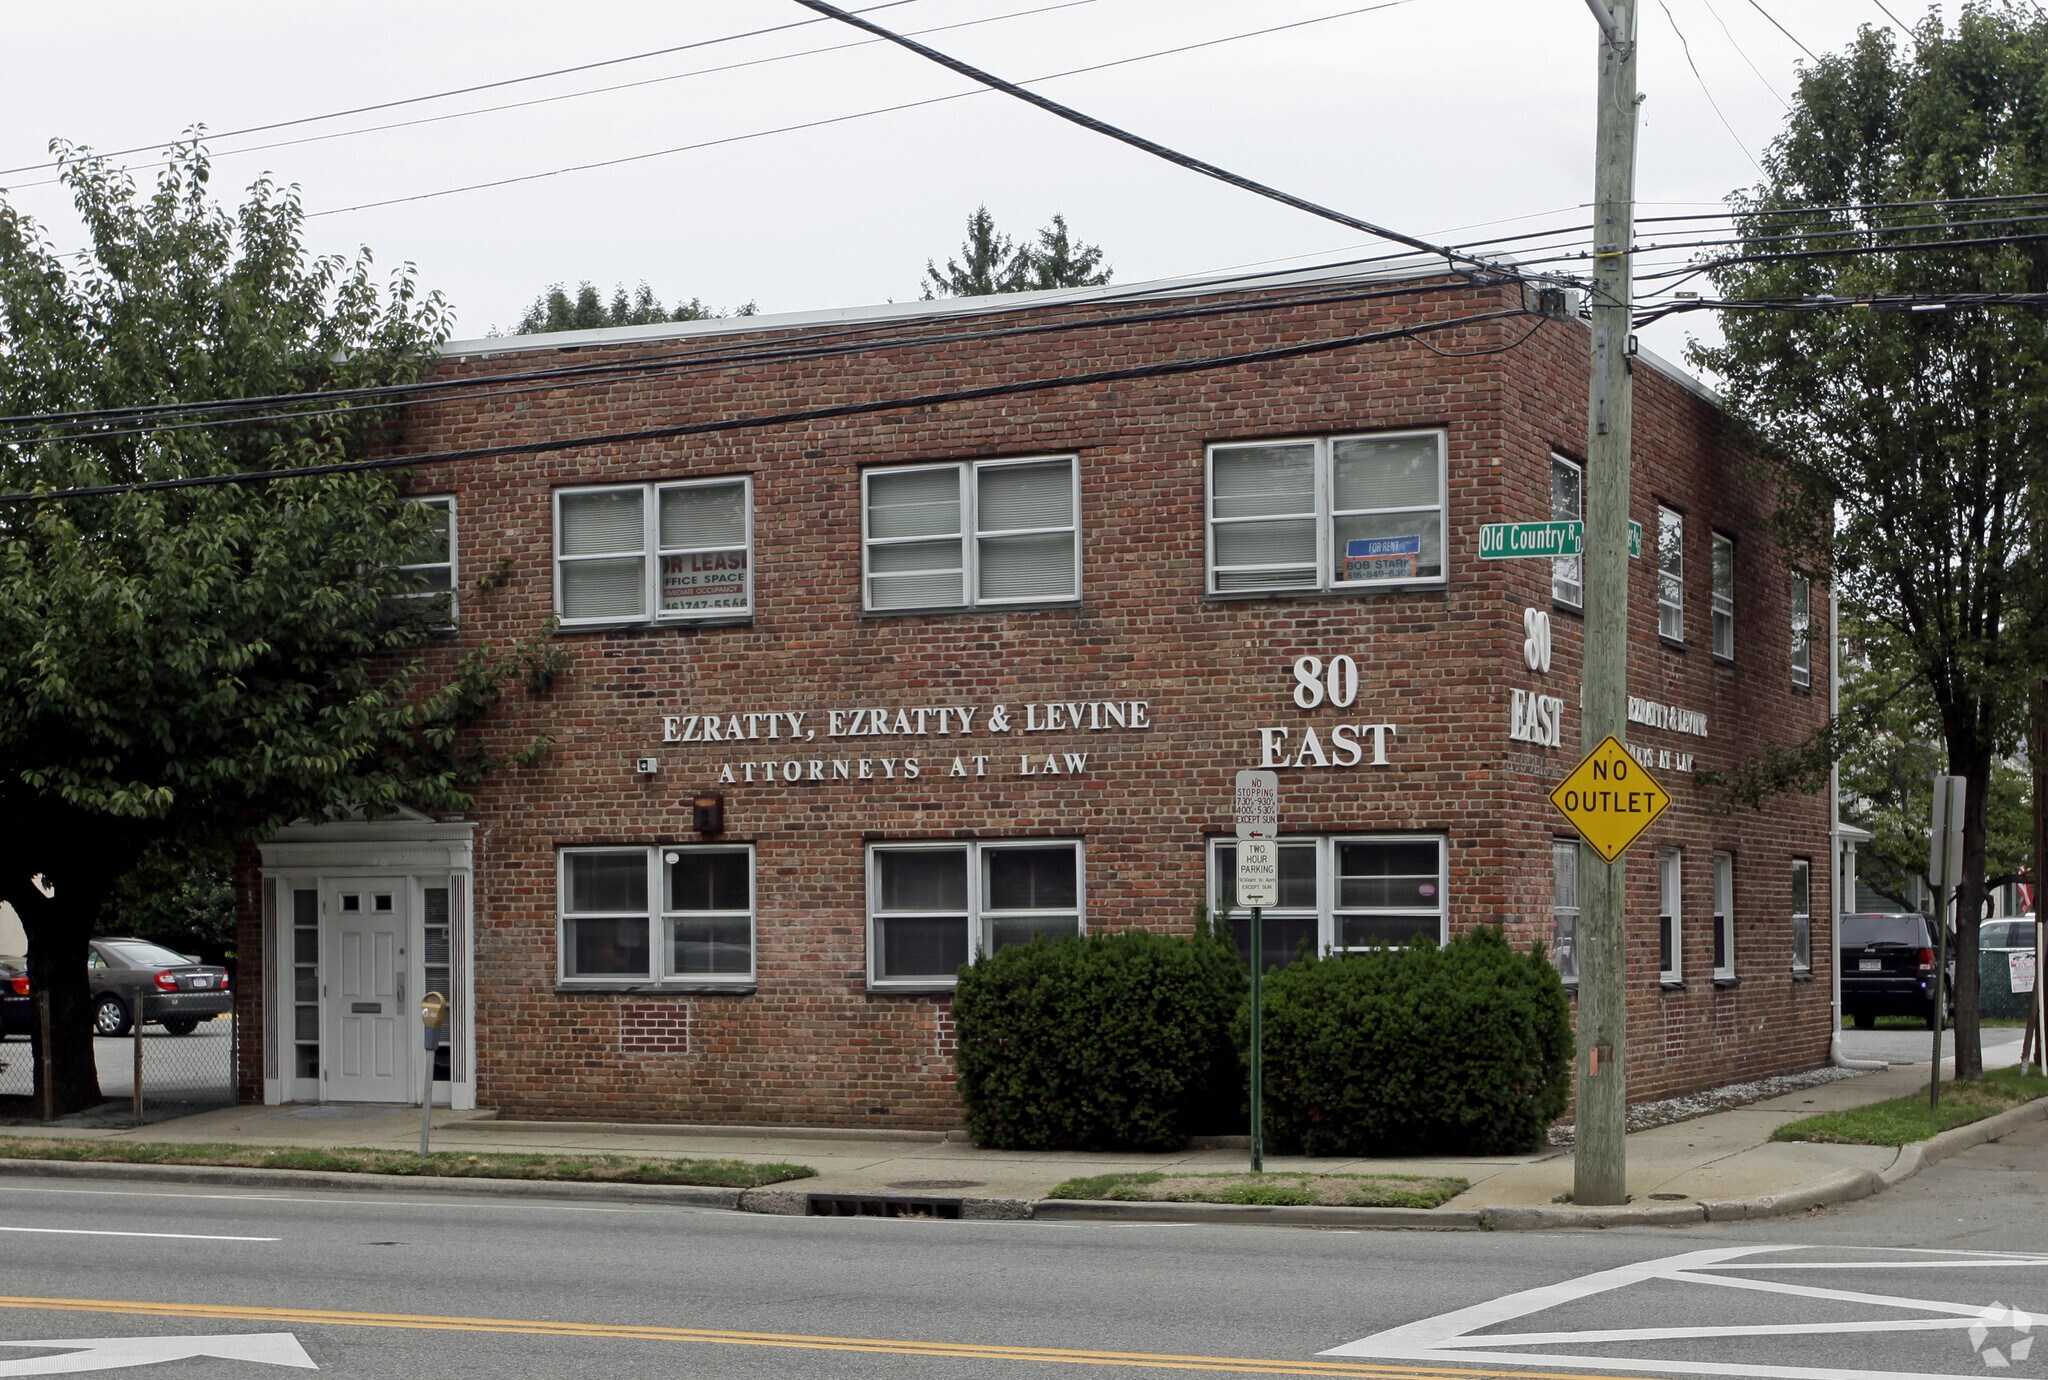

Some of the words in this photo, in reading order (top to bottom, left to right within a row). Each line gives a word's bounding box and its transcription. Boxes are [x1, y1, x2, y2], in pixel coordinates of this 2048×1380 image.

[1368, 542, 1380, 553] FOR
[1382, 541, 1399, 552] RENT
[1481, 526, 1503, 551] Old
[1510, 524, 1565, 554] Country
[1347, 561, 1370, 570] BOB
[1375, 559, 1410, 569] STARK
[665, 576, 698, 586] FFICE
[704, 573, 744, 584] SPACE
[696, 586, 738, 595] OCCUPANCY
[1523, 607, 1551, 674] 80
[1293, 654, 1359, 709] 80
[662, 709, 815, 743] EZRATTY,
[827, 706, 978, 738] EZRATTY
[988, 704, 1012, 732] &
[1025, 701, 1150, 732] LEVINE
[1509, 687, 1564, 748] EAST
[1257, 723, 1397, 769] EAST
[1659, 750, 1670, 769] AT
[718, 757, 920, 784] ATTORNEYS
[949, 755, 989, 777] AT
[1020, 752, 1090, 776] LAW
[1593, 760, 1627, 781] NO
[1252, 779, 1261, 788] NO
[1237, 788, 1274, 797] STOPPING
[1564, 791, 1656, 813] OUTLET
[1236, 815, 1260, 824] EXCEPT
[1249, 845, 1265, 853] TWO
[1246, 855, 1267, 863] HOUR
[1241, 865, 1273, 873] PARKING
